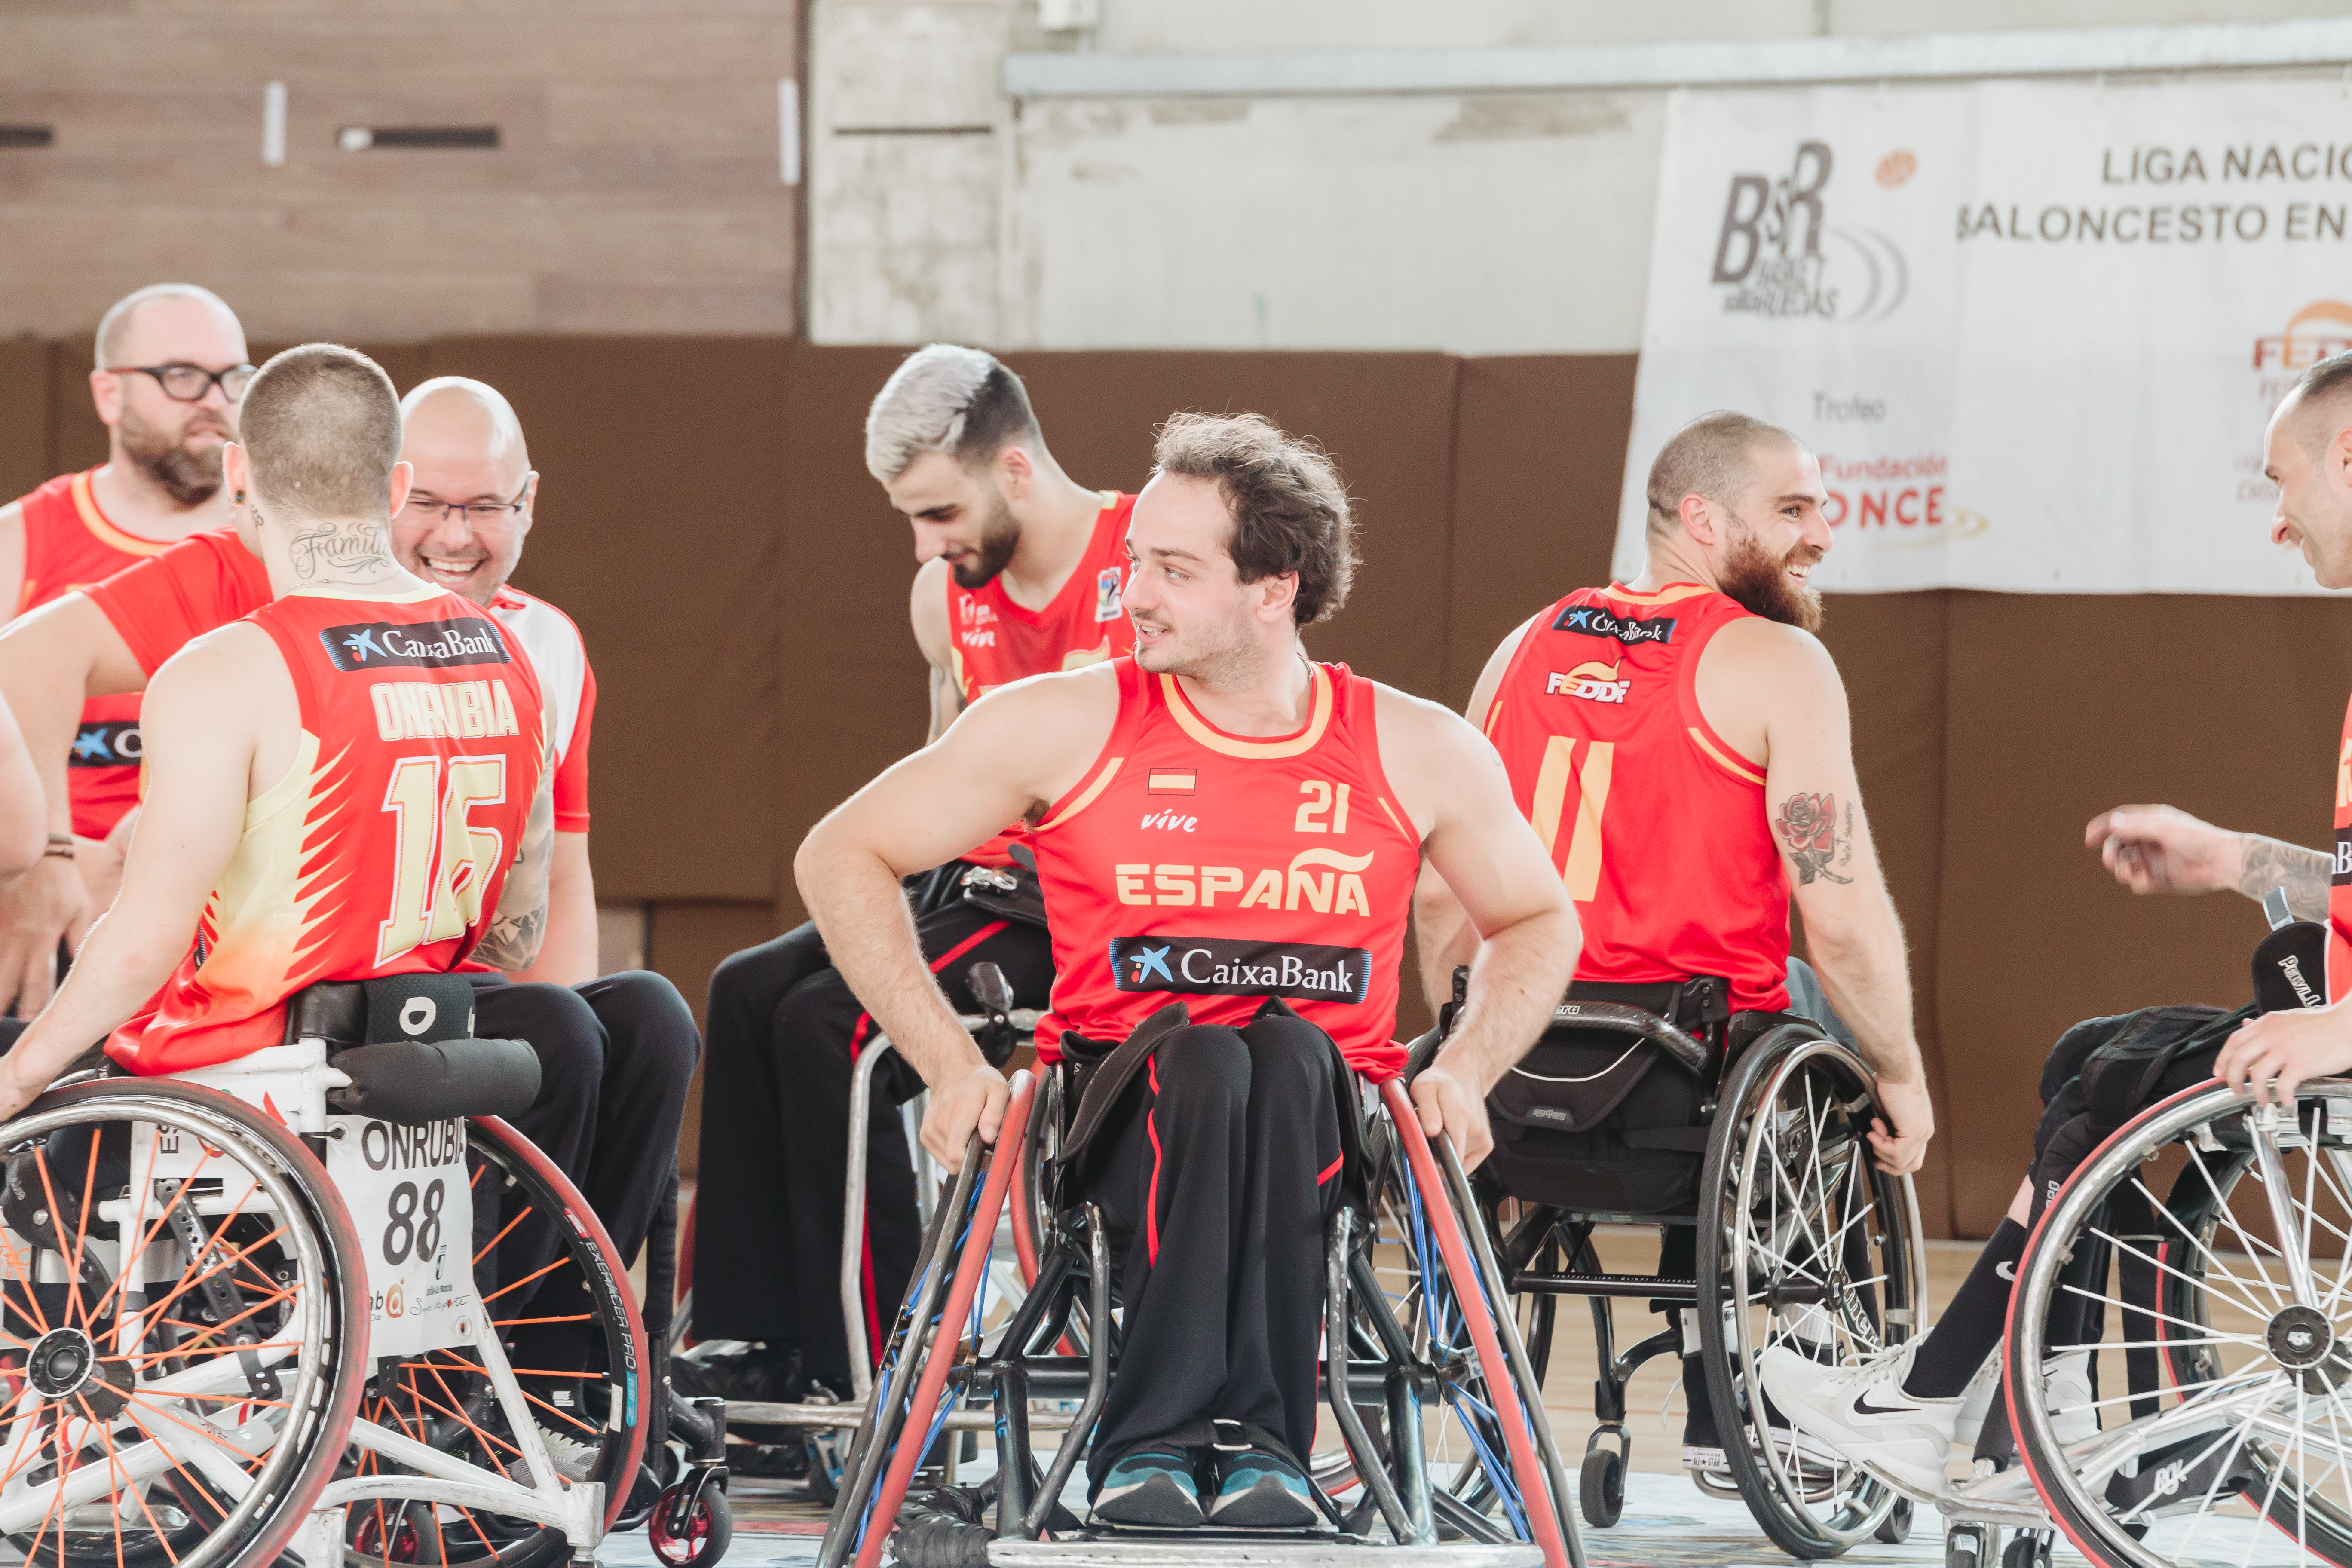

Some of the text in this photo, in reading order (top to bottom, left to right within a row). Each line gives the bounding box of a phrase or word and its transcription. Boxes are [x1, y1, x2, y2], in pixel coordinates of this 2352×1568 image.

[2102, 147, 2208, 184] LIGA
[2285, 202, 2346, 240] EN
[1812, 391, 1886, 422] Trofeo
[1821, 485, 1944, 529] ONCE
[381, 629, 499, 659] CaixaBank
[1545, 670, 1632, 705] FEDDF
[370, 679, 520, 742] ONRUBIA
[1294, 779, 1351, 834] 21
[1531, 735, 1615, 902] 11
[1115, 848, 1374, 917] ESPAÑA
[1181, 949, 1353, 993] CaixaBank
[383, 1178, 444, 1266] 88
[621, 1332, 637, 1370] PRO
